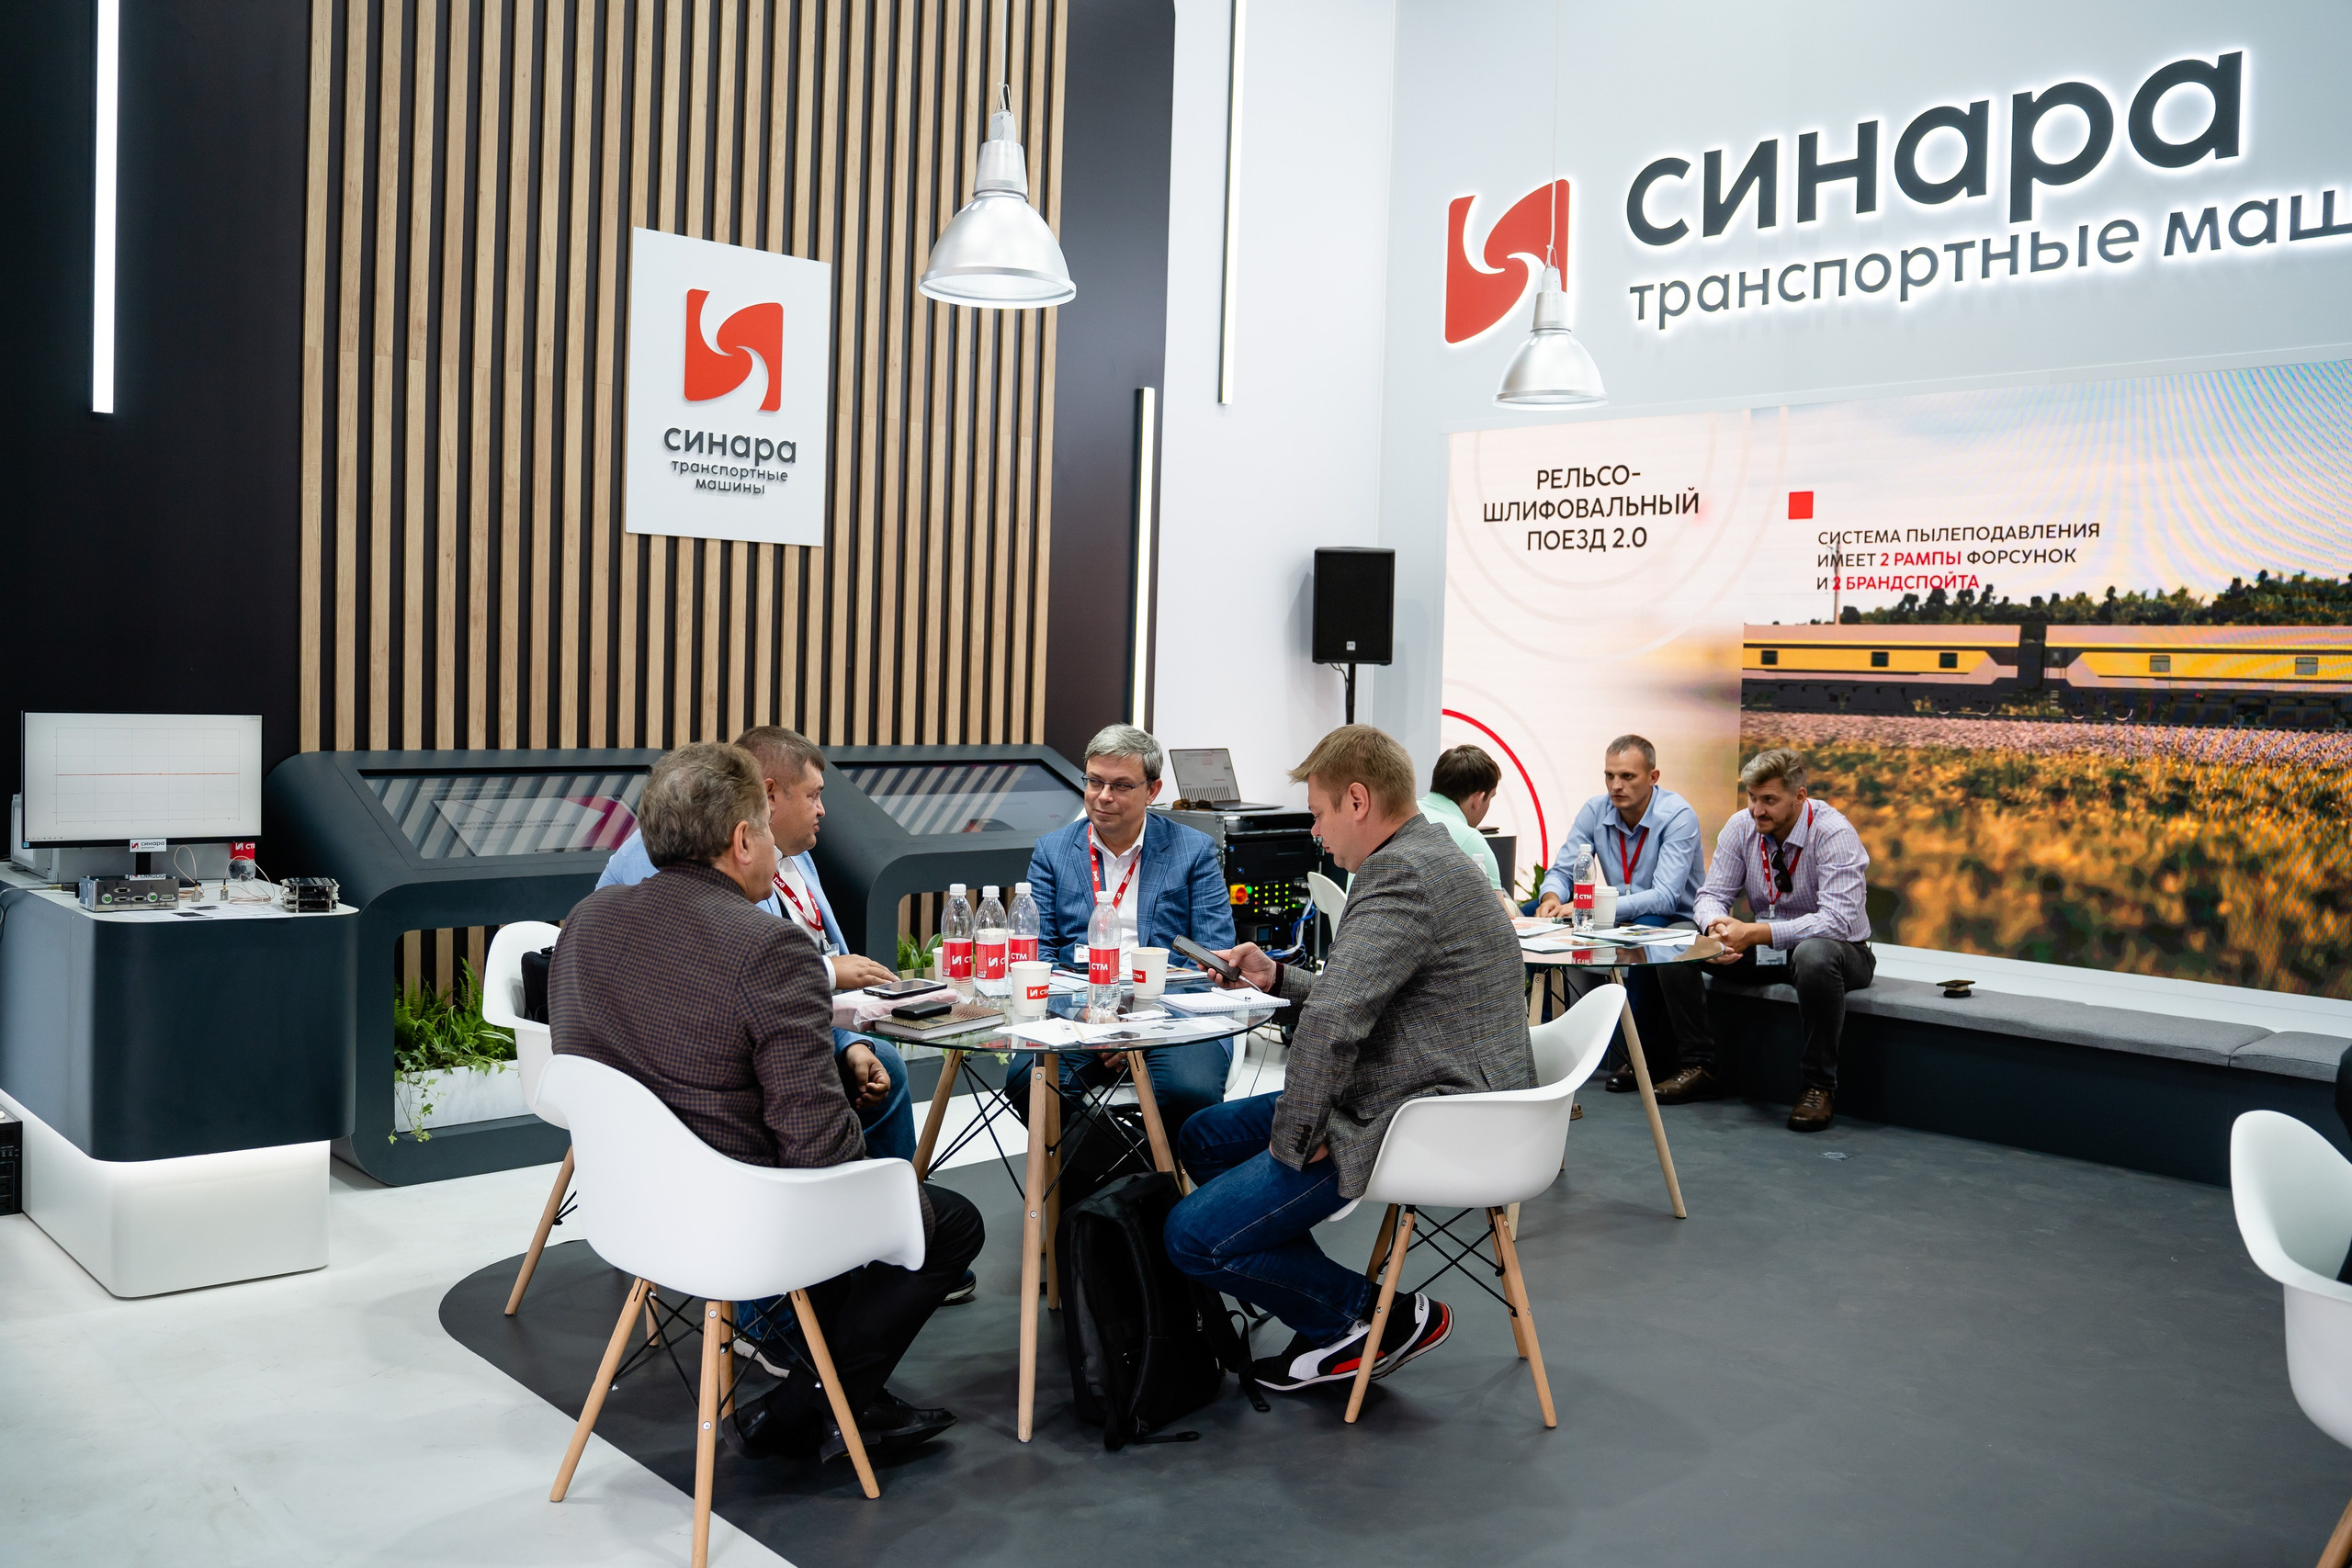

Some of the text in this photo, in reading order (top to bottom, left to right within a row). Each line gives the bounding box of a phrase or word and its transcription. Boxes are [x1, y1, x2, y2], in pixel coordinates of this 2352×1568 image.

[1627, 51, 2242, 245] синара
[1630, 220, 2138, 330] транспортные
[664, 428, 796, 467] синара
[672, 460, 787, 481] транспортные
[1536, 465, 1641, 490] РЕЛЬСО-
[695, 479, 765, 494] машины
[1484, 487, 1700, 523] ШЛИФОВАЛЬНЫЙ
[1527, 527, 1648, 553] ПОЕЗД 2.0
[1817, 523, 2100, 546] СИСТЕМА ПЫЛЕПОДАВЛЕНИЯ
[1817, 548, 2076, 568] ИМЕЕТ 2 РАМПЫ ФОРСУНОК
[1817, 577, 1828, 591] И
[1846, 572, 1980, 592] БРАНДСПОЙТА
